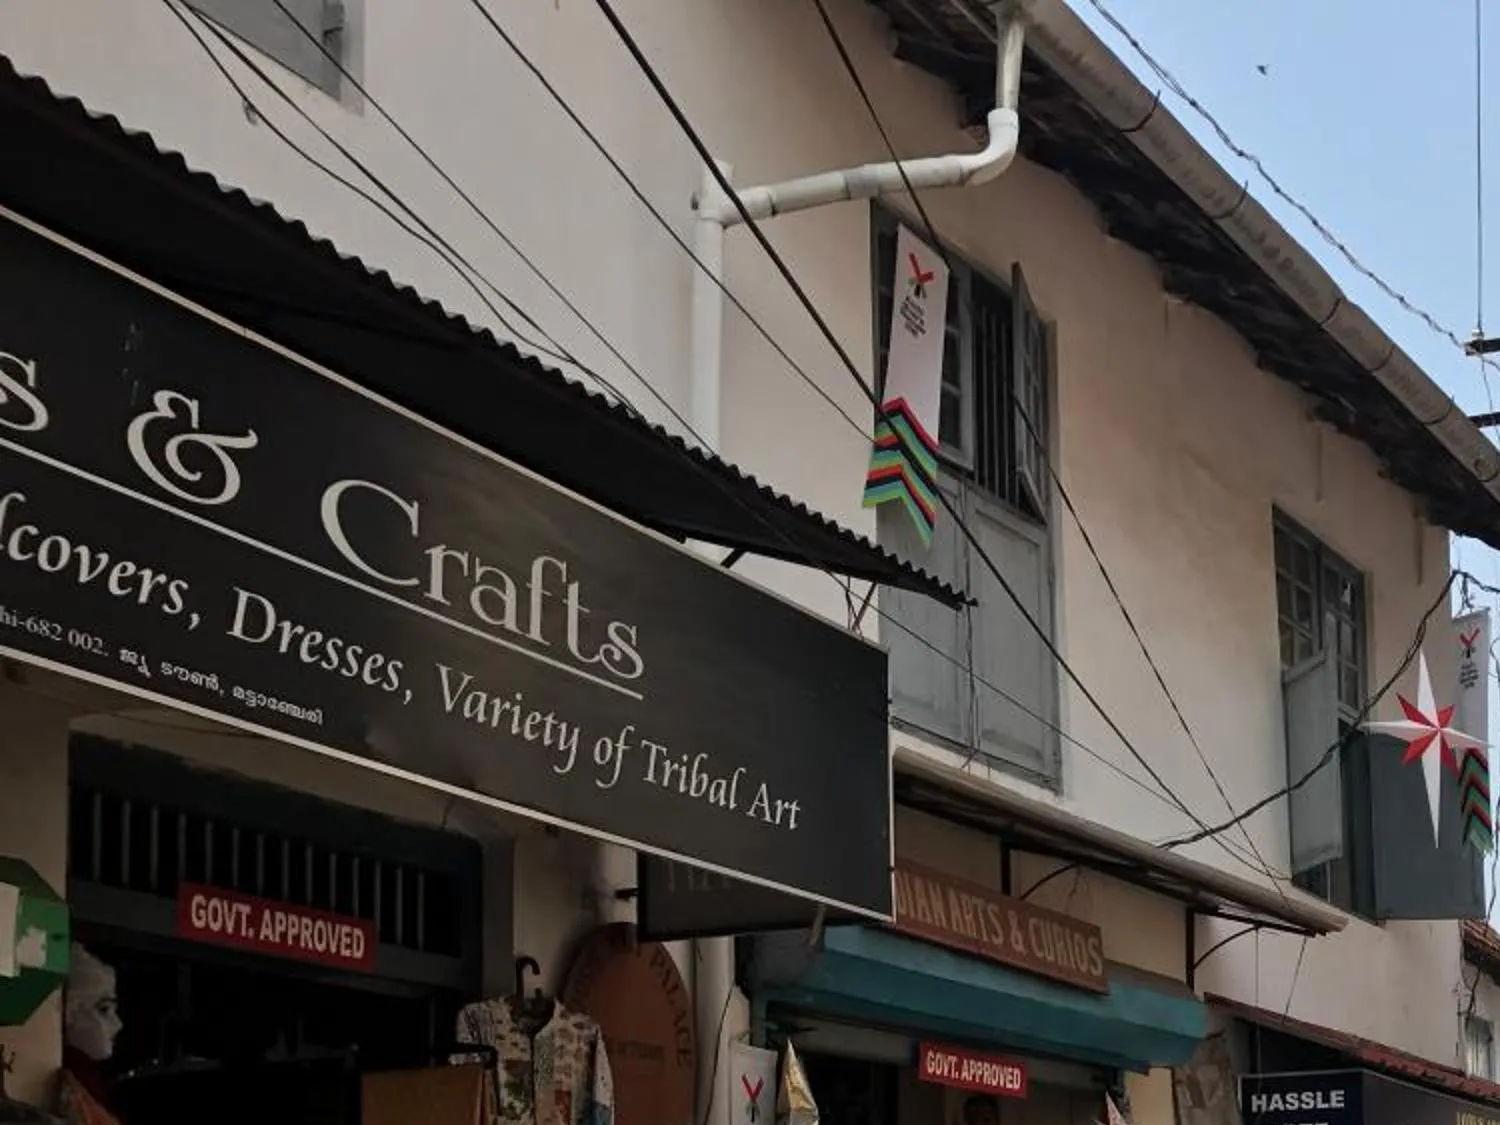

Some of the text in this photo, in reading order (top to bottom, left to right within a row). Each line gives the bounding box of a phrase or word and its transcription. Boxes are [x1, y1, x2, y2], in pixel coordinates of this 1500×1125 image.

[127, 388, 259, 506] &
[320, 478, 645, 680] Crafts
[67, 628, 109, 657] 002.
[228, 586, 414, 705] Dresses,
[436, 662, 580, 774] Variety
[594, 726, 635, 788] of
[641, 738, 746, 812] Tribal
[747, 782, 802, 831] Art
[191, 894, 365, 960] GOVT. APPROVED
[949, 887, 1004, 945] ARTS
[1008, 909, 1027, 954] &
[1028, 916, 1103, 977] CURIOS
[926, 1049, 1022, 1091] GOVT. APPROVED
[1251, 1089, 1345, 1114] HASSLE
